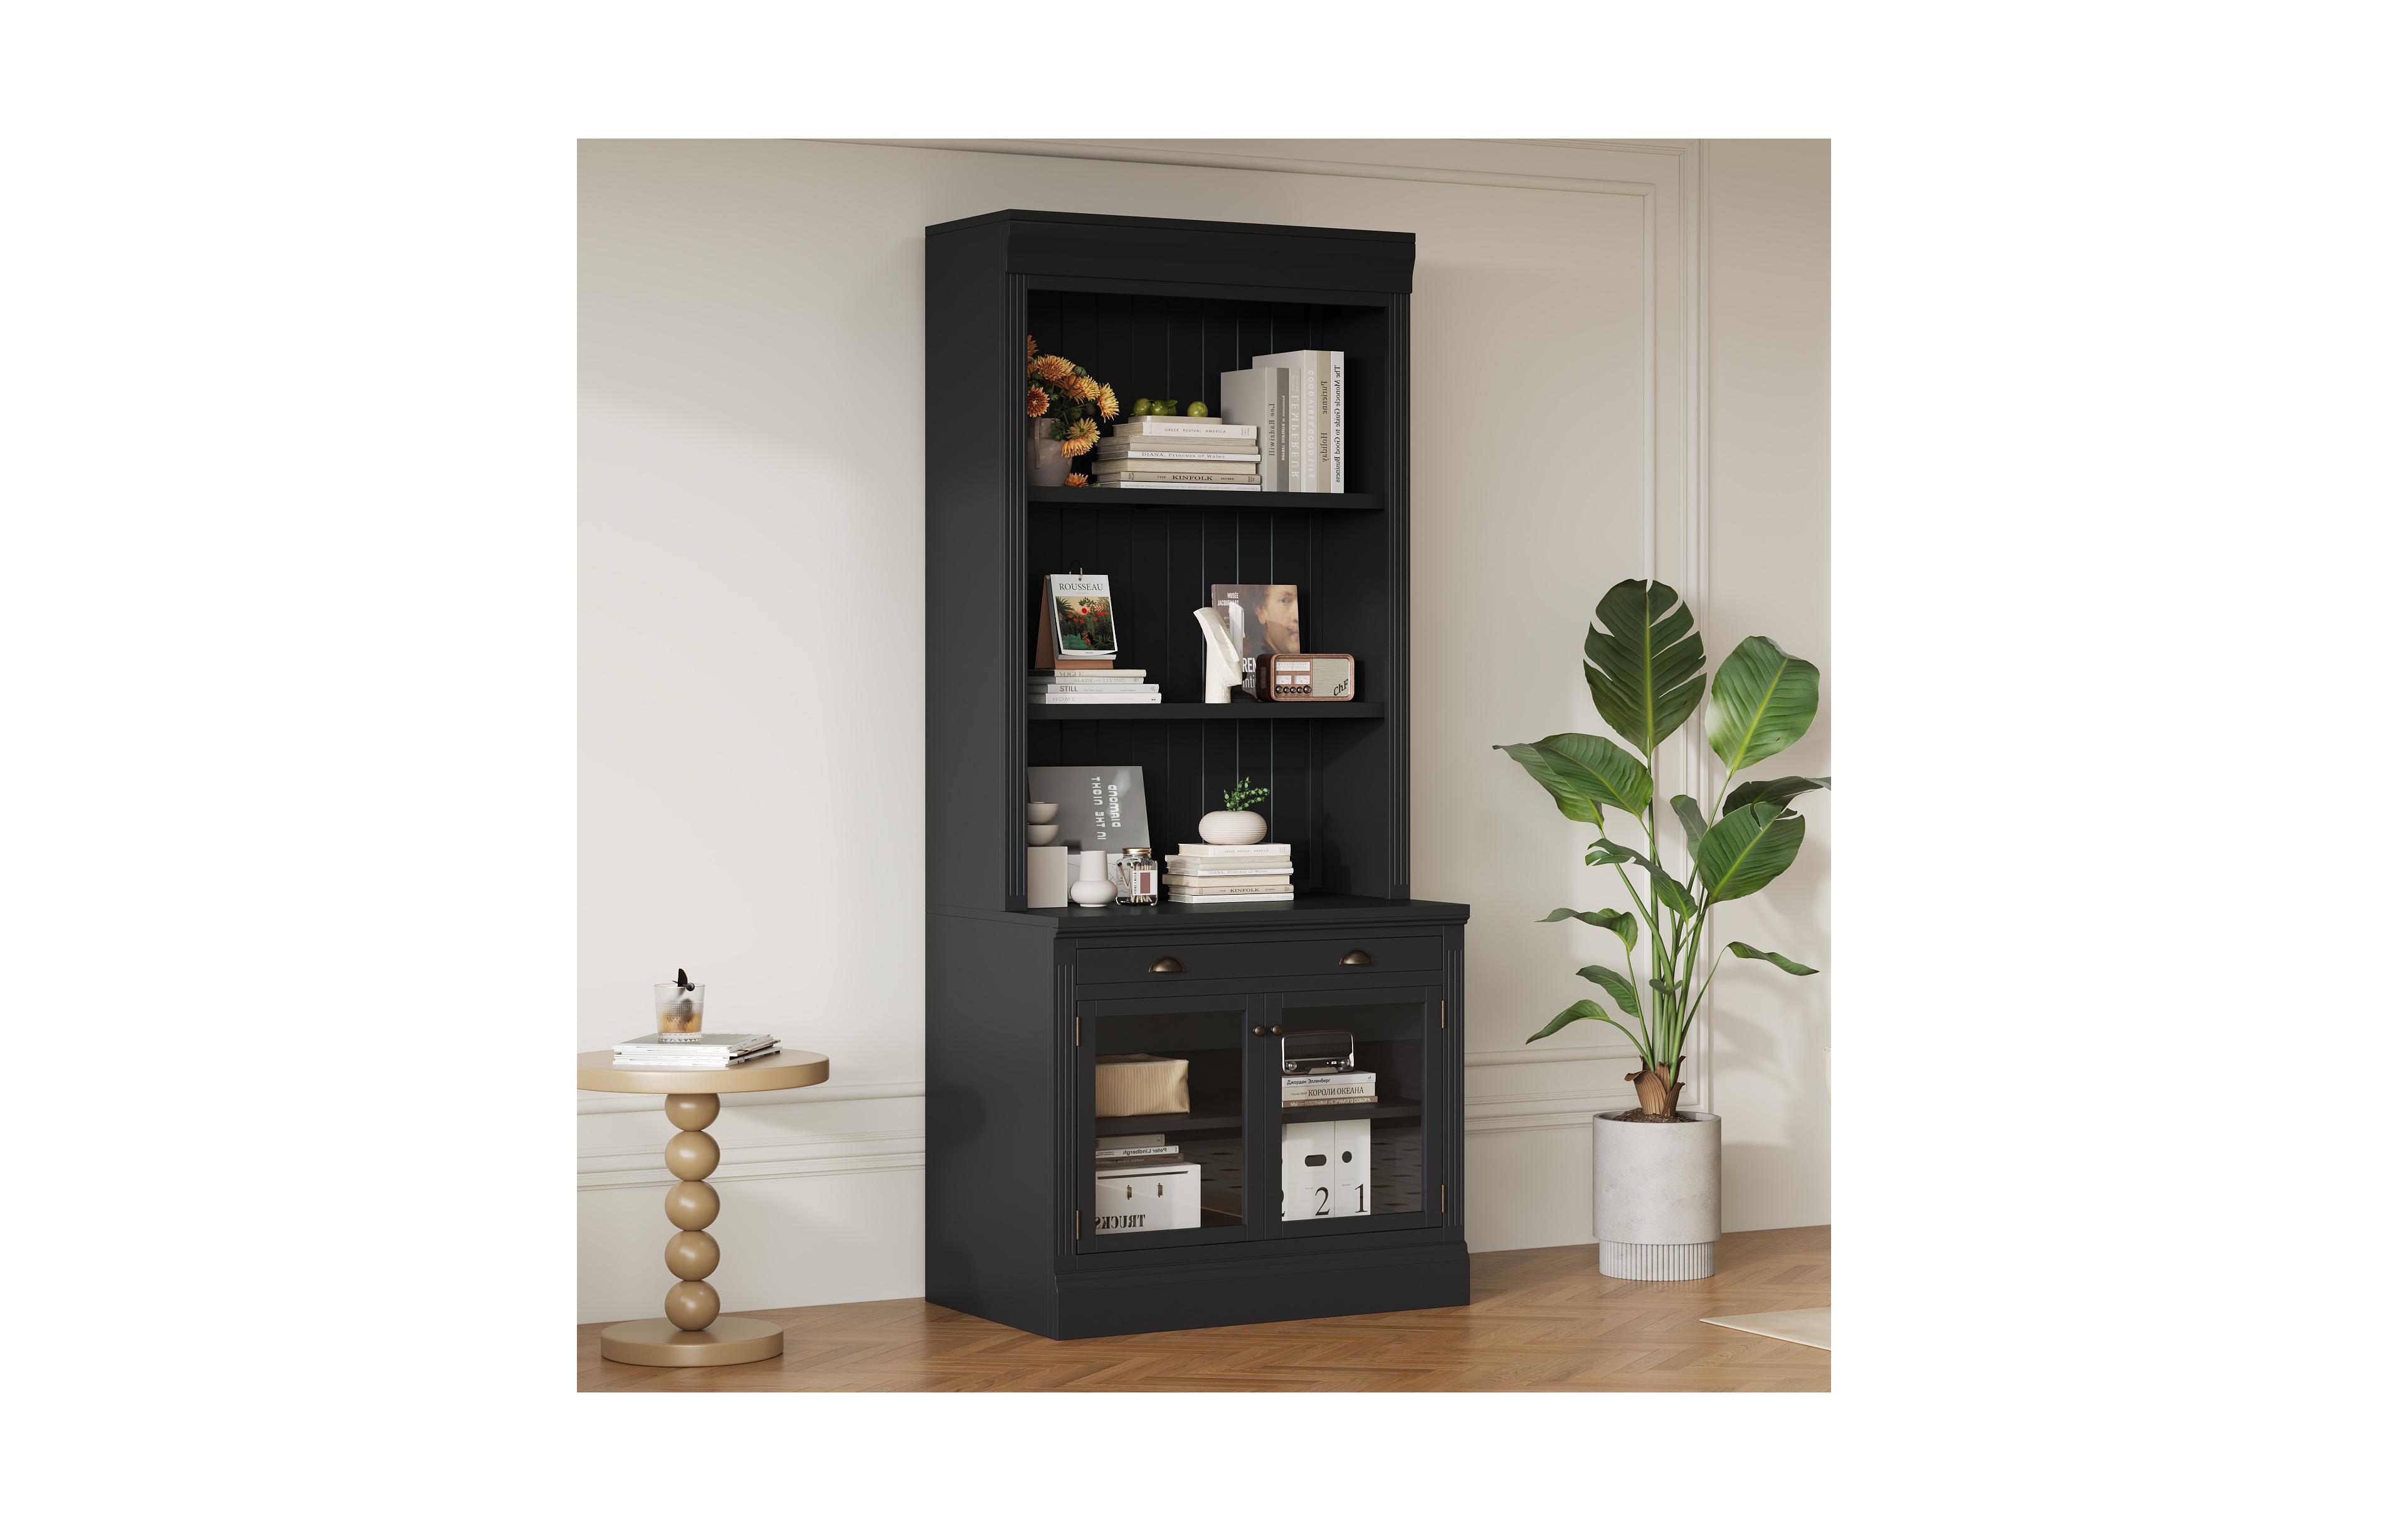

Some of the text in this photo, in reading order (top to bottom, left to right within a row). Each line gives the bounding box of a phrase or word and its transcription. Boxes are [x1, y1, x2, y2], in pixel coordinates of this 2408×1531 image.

[1308, 1086, 1364, 1097] КОРОЛИ ОКЕАНА
[1315, 1186, 1330, 1216] 2
[1354, 1183, 1368, 1213] 1
